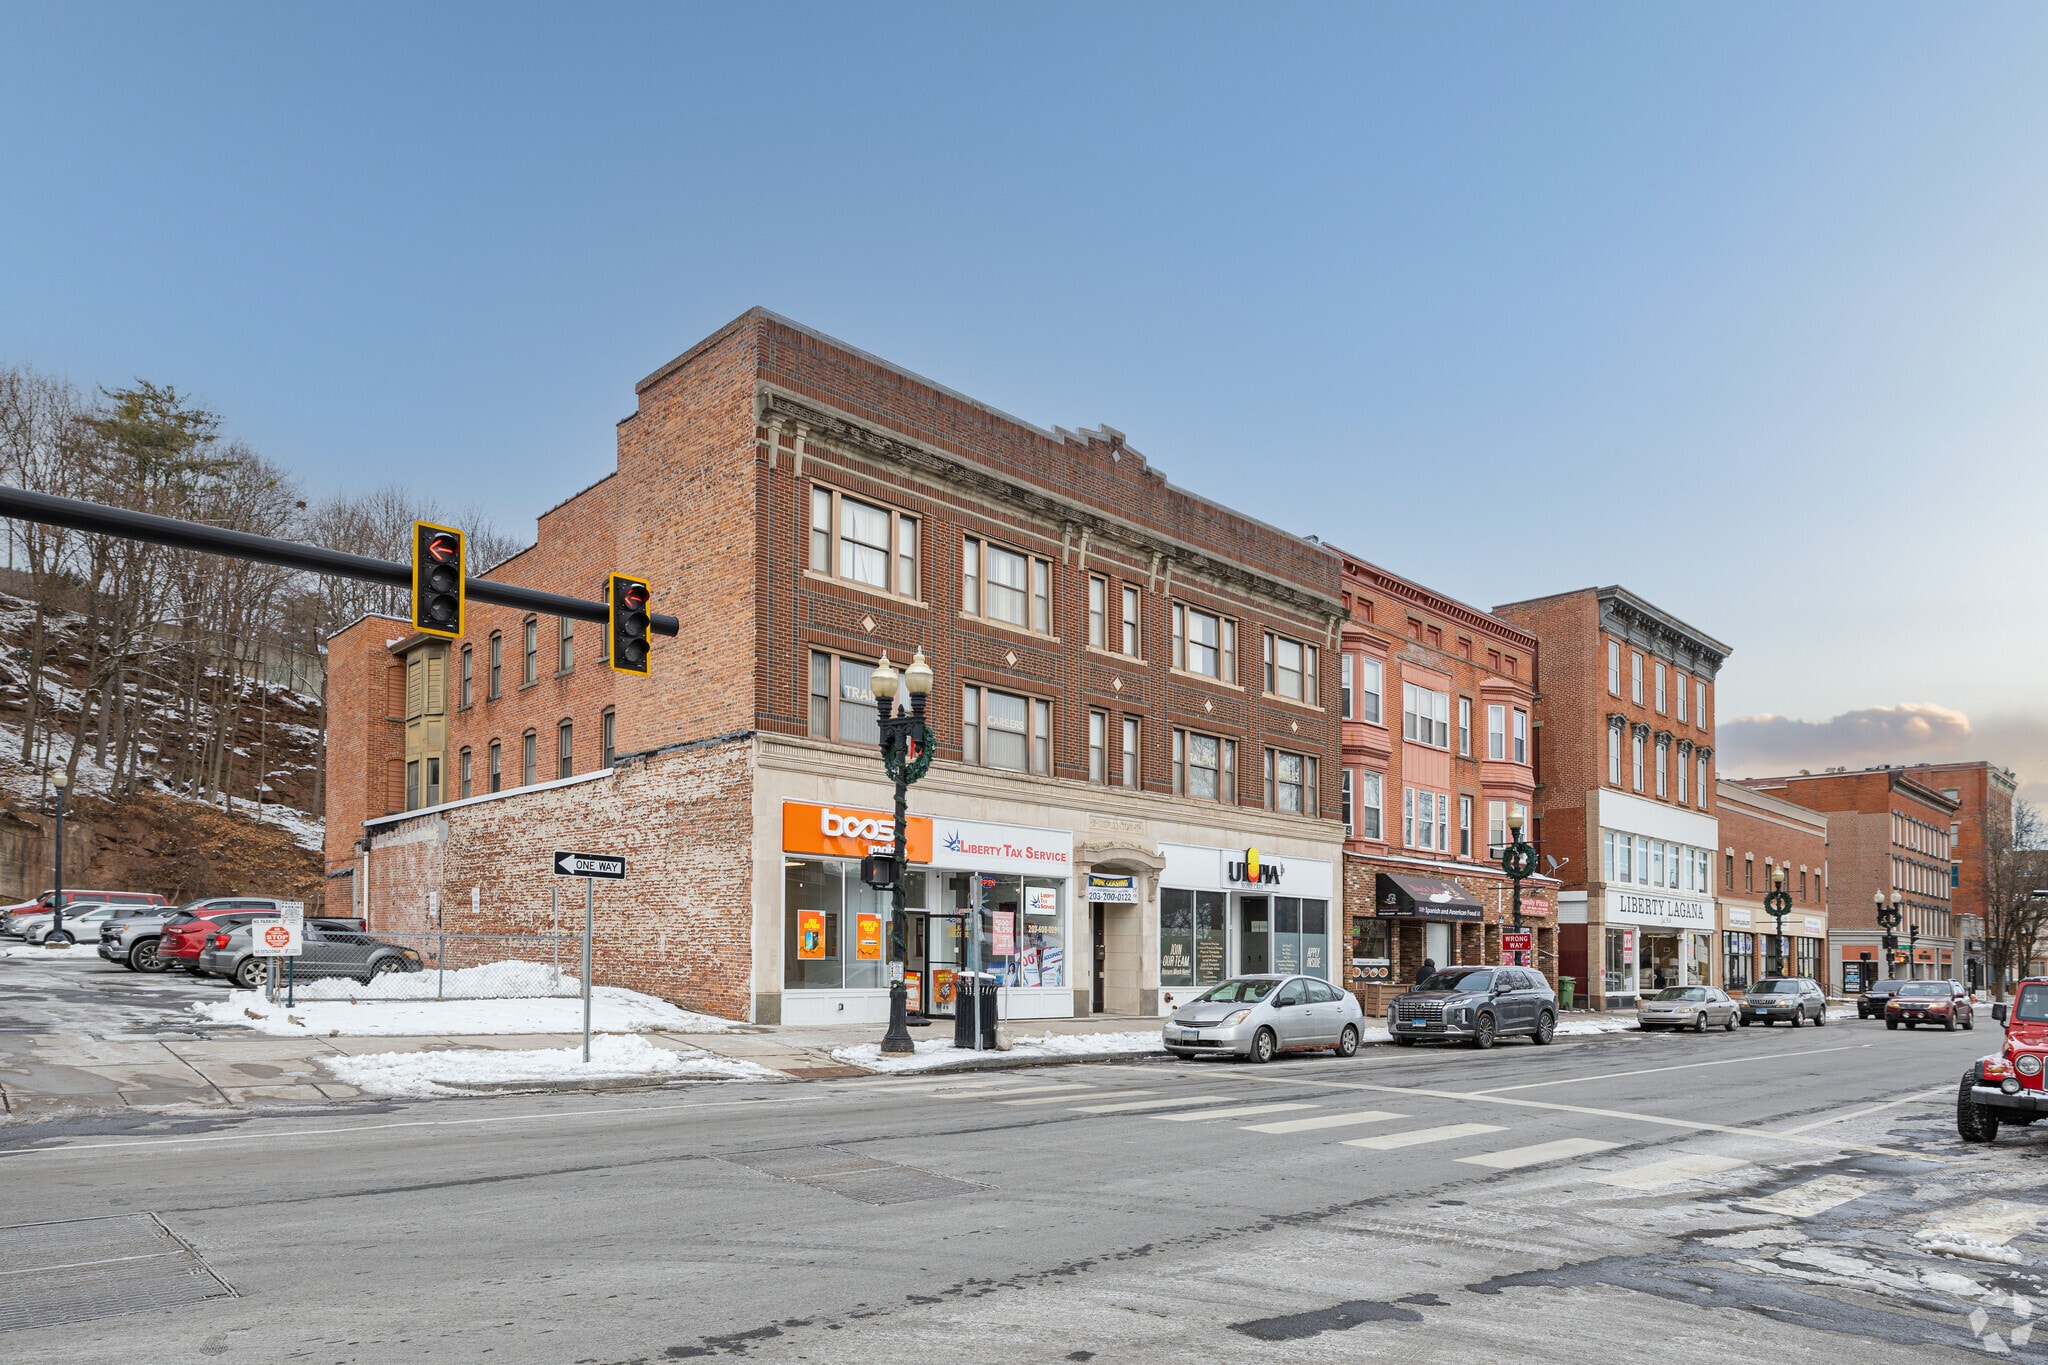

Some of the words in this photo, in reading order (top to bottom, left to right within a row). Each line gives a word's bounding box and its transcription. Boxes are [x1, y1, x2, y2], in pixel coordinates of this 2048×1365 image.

[988, 715, 1024, 730] CAREERS
[821, 808, 896, 842] boos
[960, 840, 1002, 856] LIBERTY
[1003, 844, 1023, 858] TAX
[1025, 846, 1067, 862] SERVICE
[576, 860, 595, 870] ONE
[598, 862, 618, 872] WAY
[981, 879, 996, 887] PEN
[1424, 906, 1440, 914] Spanish
[1448, 908, 1467, 916] American
[1620, 896, 1664, 915] LIBERTY
[1668, 901, 1704, 919] LAGANA
[1170, 944, 1183, 955] JOIN
[1162, 955, 1174, 967] OUR
[1175, 956, 1190, 967] TEAM
